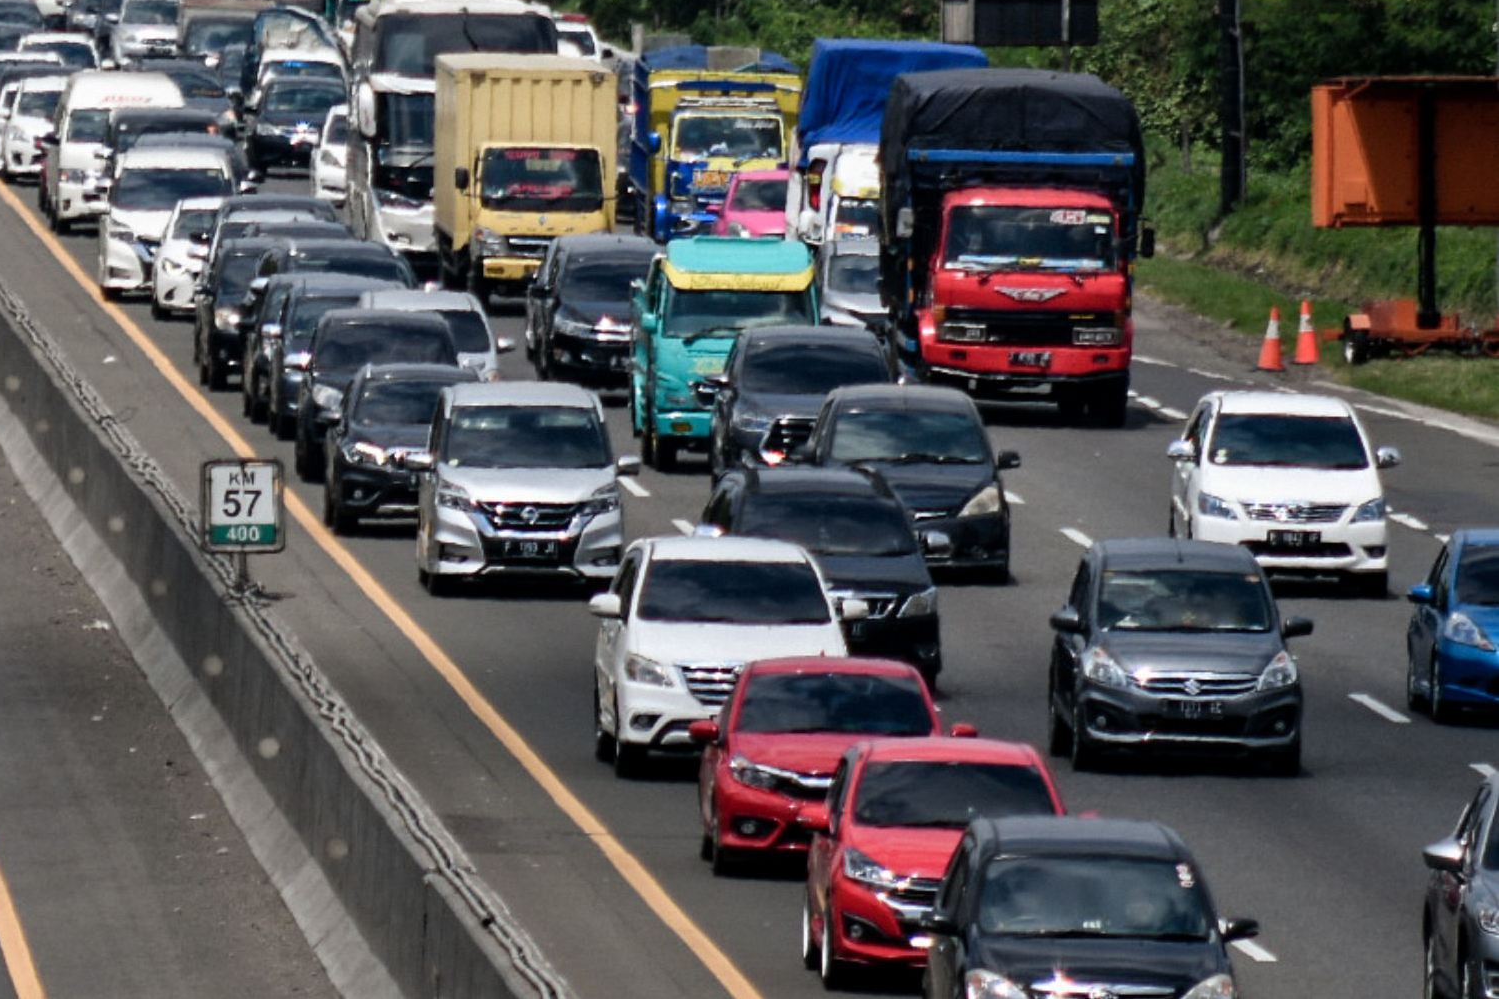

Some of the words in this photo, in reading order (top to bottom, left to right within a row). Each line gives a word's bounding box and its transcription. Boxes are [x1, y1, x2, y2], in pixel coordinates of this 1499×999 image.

[229, 471, 256, 486] KM
[222, 489, 262, 518] 57
[226, 525, 261, 542] 400
